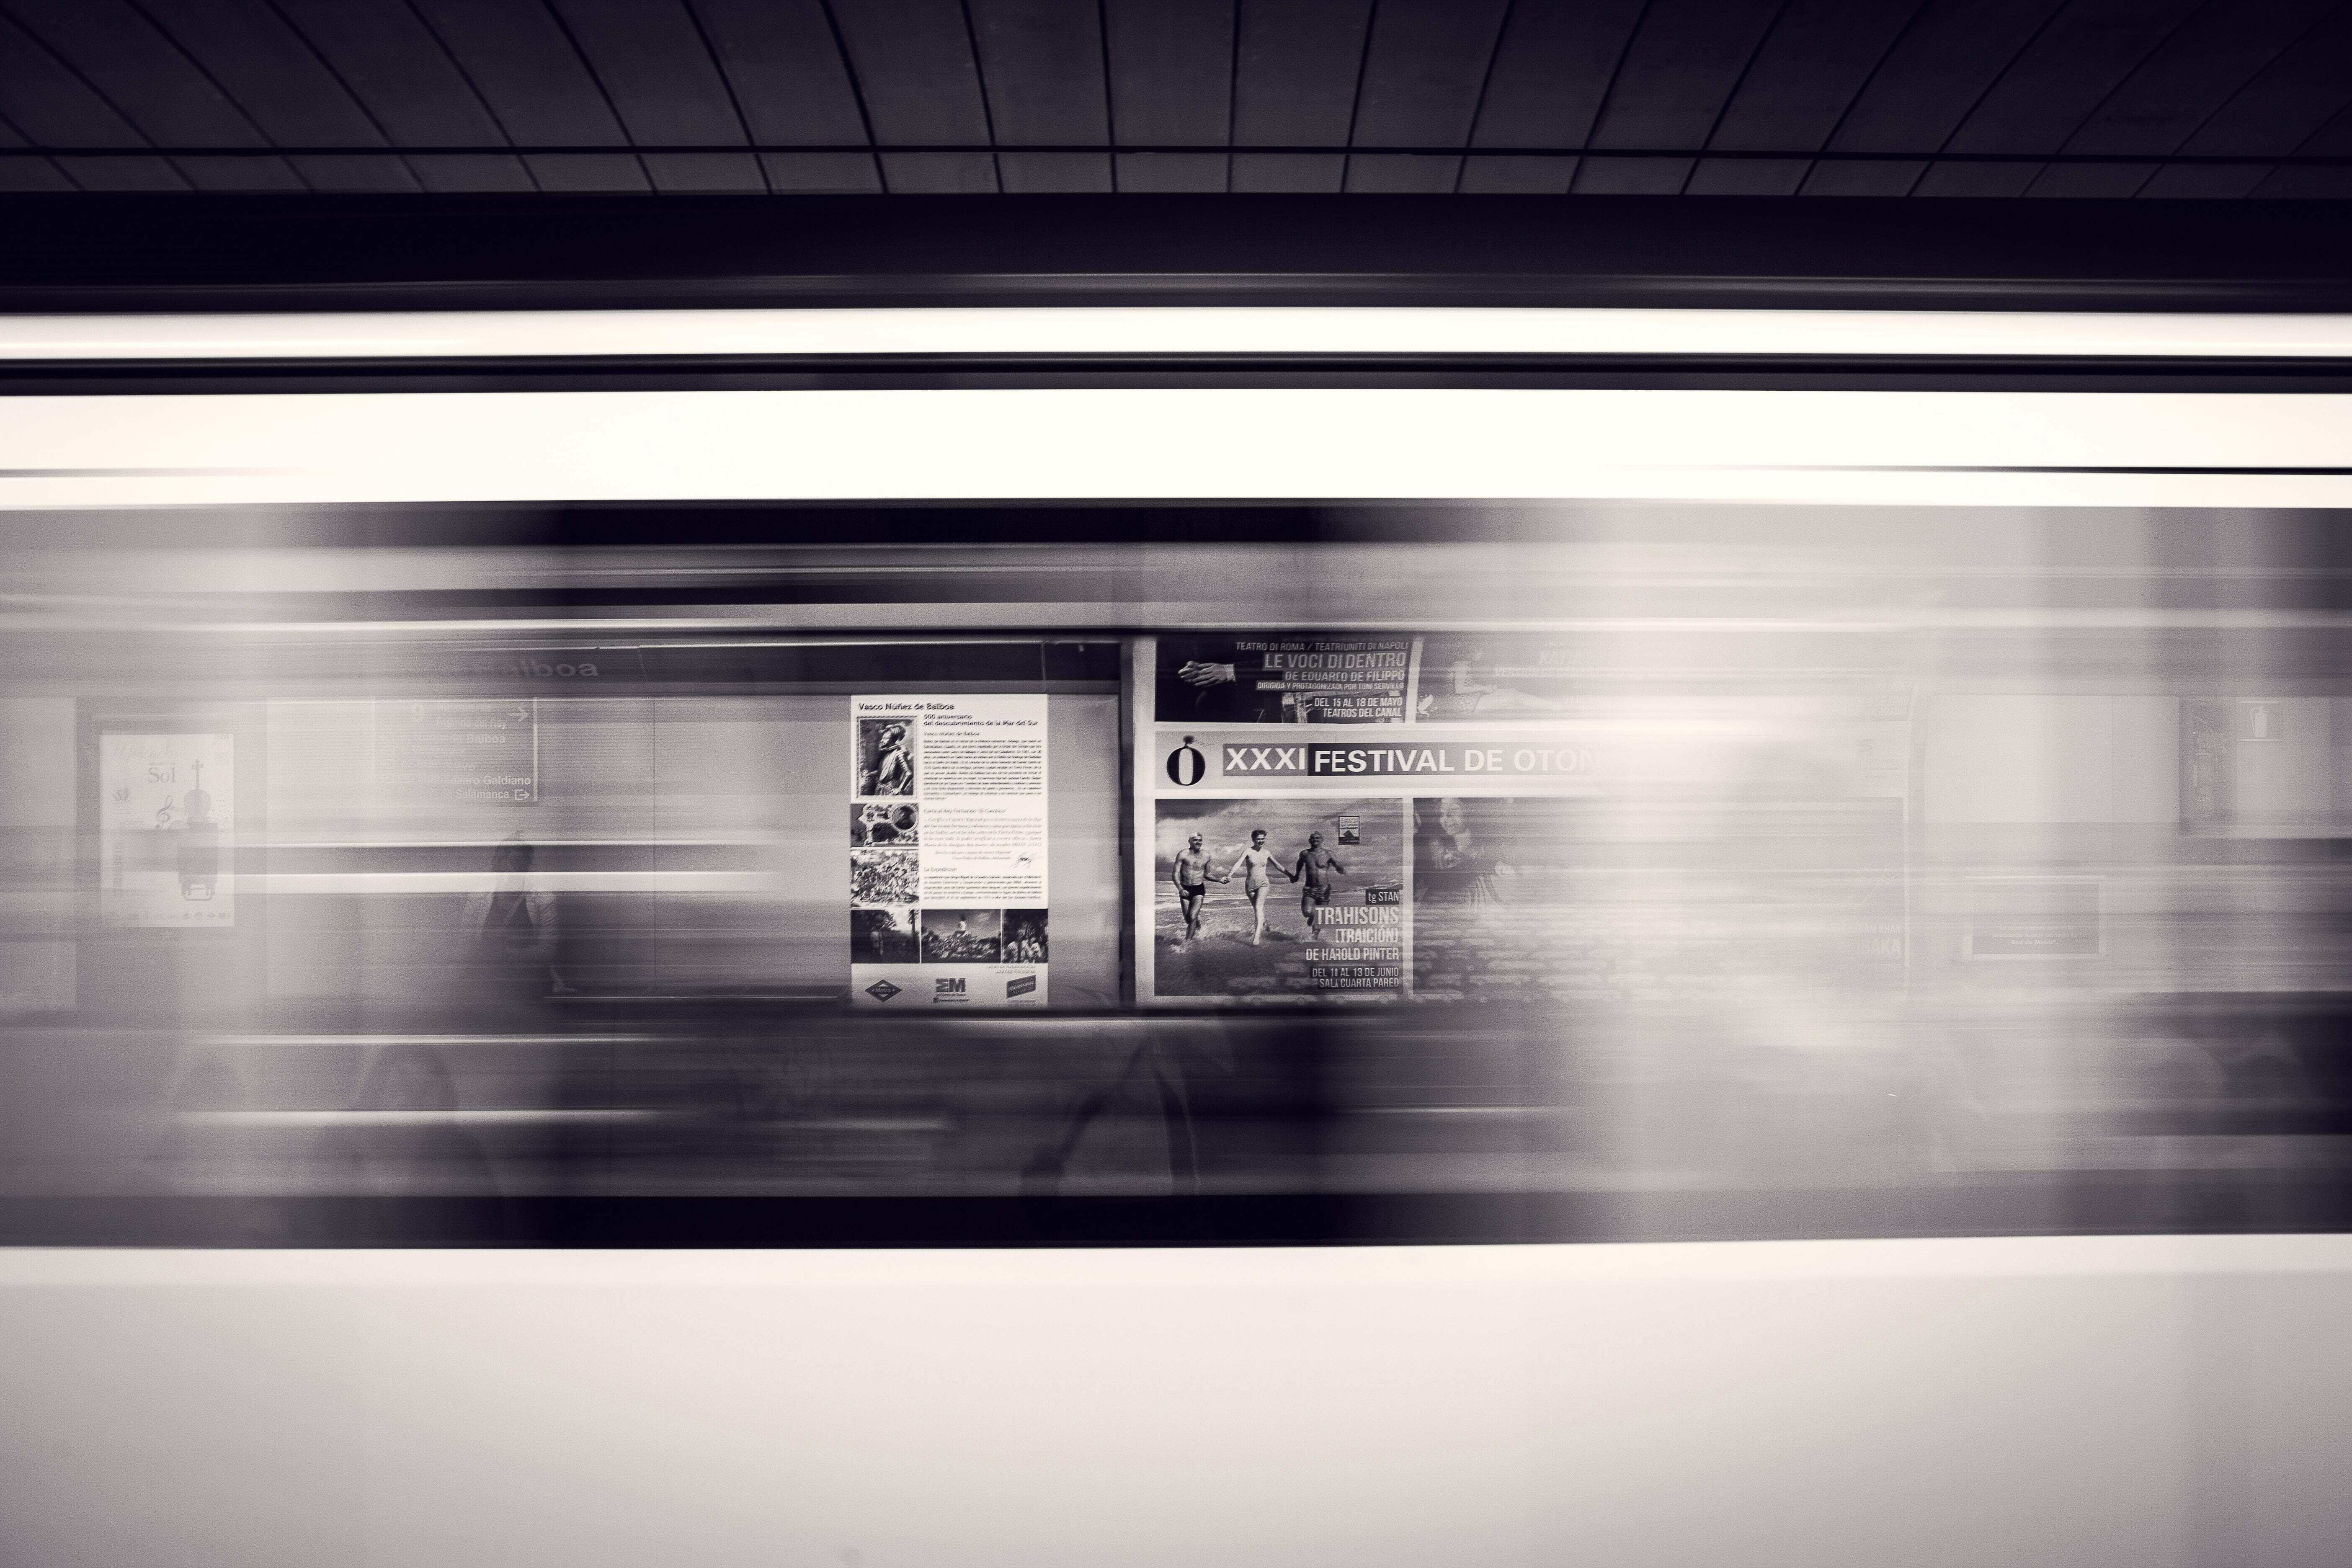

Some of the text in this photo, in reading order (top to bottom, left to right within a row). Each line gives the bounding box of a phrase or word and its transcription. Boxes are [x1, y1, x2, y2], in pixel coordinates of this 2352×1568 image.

[1236, 642, 1266, 651] TEATRO
[1269, 642, 1278, 651] DI
[1280, 642, 1305, 651] ROMA
[1265, 652, 1406, 668] LE VOCI DI DENTRO
[1285, 670, 1404, 681] DE EDUARDO DE FILIPPO
[1314, 697, 1403, 707] DEL 15 AL 18 DE MAYO
[1323, 708, 1403, 717] TEATROS DEL CANAL
[467, 733, 506, 743] Balboa
[1225, 747, 1306, 771] XXXI
[1314, 749, 1454, 772] FESTIVAL
[1465, 749, 1504, 771] DE
[148, 766, 176, 784] Sol
[482, 775, 531, 785] Galdiano
[455, 789, 510, 799] Salamanca
[1368, 891, 1400, 903] tg STAN
[1315, 906, 1400, 925] TRAHISONS
[1306, 948, 1399, 960] DE HAROLD PINTER
[1312, 968, 1327, 977] DEL
[1341, 968, 1350, 976] AL
[1353, 967, 1362, 976] 13
[1364, 967, 1375, 976] DE
[1377, 967, 1399, 976] JUNIO
[1320, 977, 1399, 988] SALA CUARTA PARED
